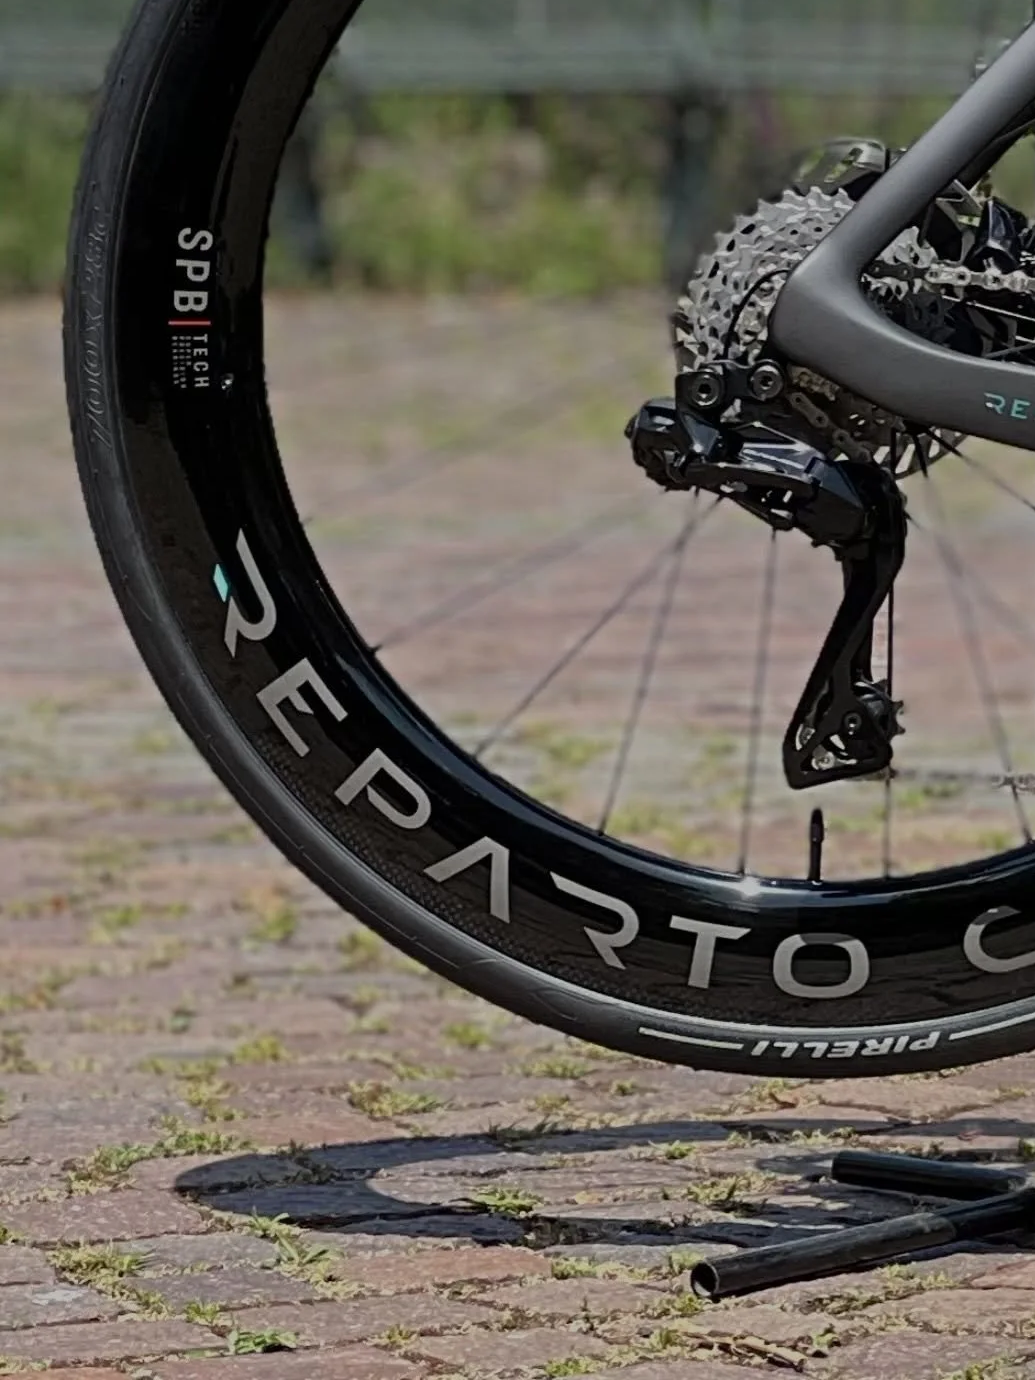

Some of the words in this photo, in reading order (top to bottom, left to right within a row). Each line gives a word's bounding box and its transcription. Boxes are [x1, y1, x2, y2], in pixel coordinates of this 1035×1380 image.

[173, 226, 214, 313] SPB
[192, 333, 211, 389] TECH
[212, 527, 871, 1000] REPARTO
[750, 1030, 941, 1059] PIRELLI
